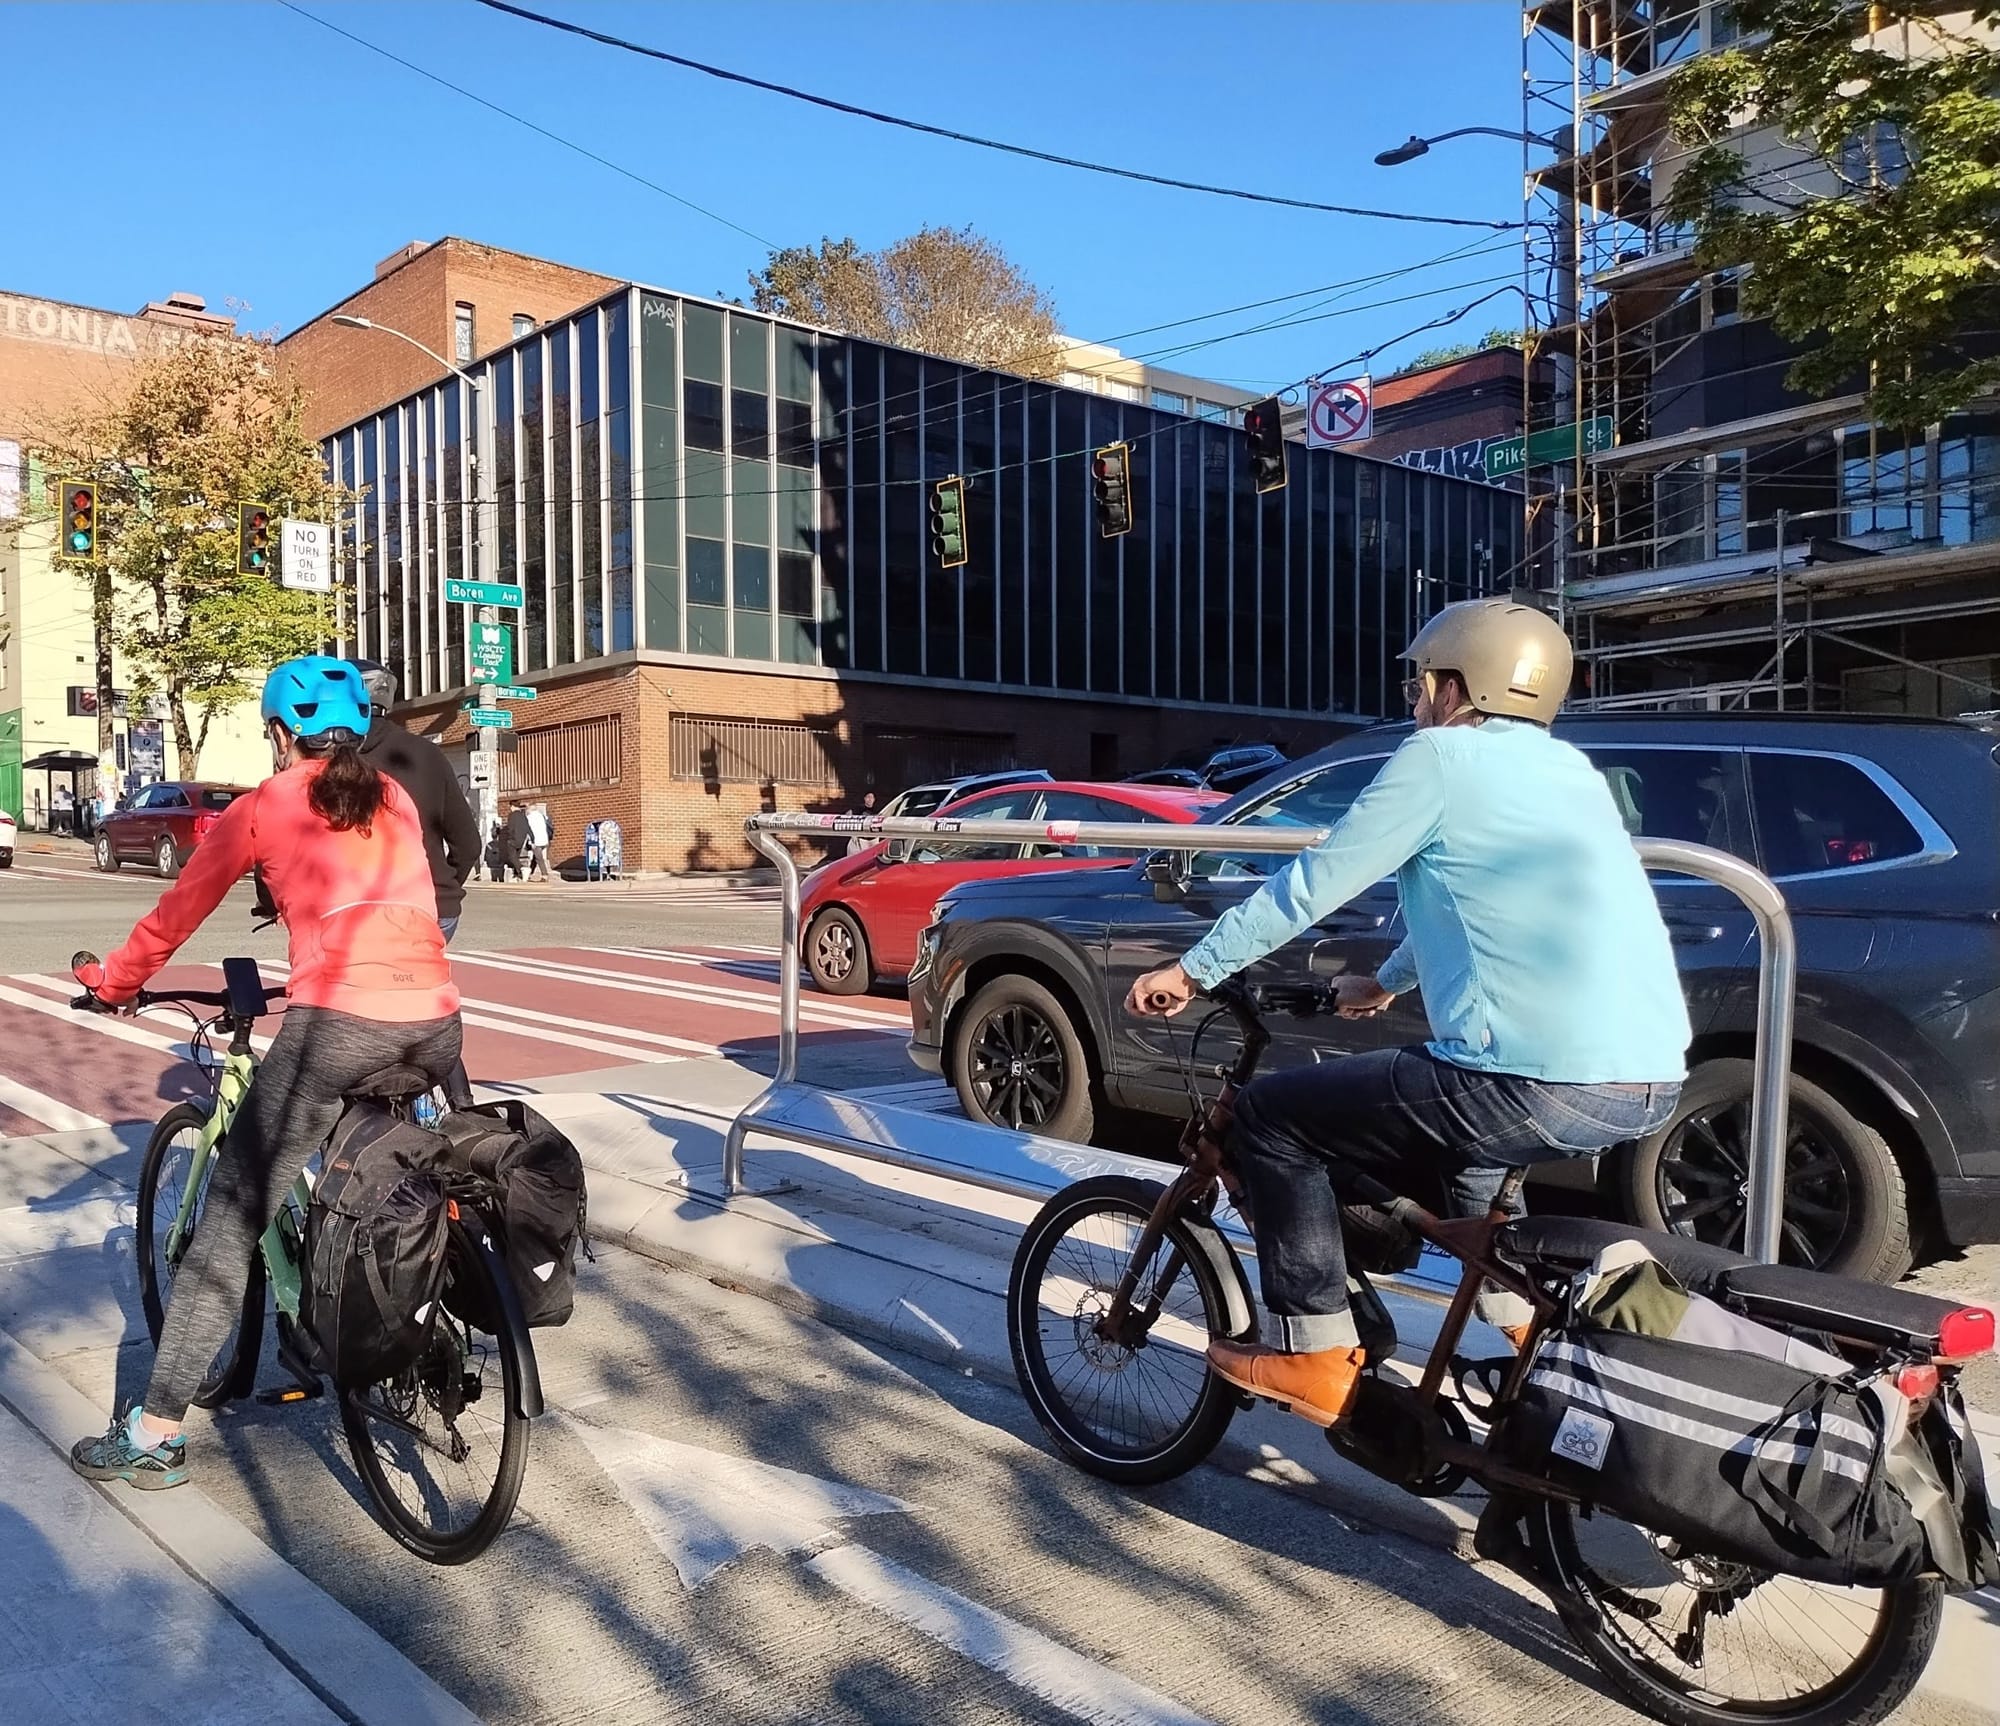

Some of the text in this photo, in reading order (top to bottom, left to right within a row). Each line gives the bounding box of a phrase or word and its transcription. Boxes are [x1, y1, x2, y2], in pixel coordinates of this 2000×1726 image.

[295, 529, 317, 543] NO
[292, 544, 320, 557] TURN
[299, 558, 313, 569] ON
[296, 571, 317, 583] RED
[451, 584, 518, 602] Boren Ave
[473, 754, 488, 763] ONE
[473, 764, 488, 773] WAY
